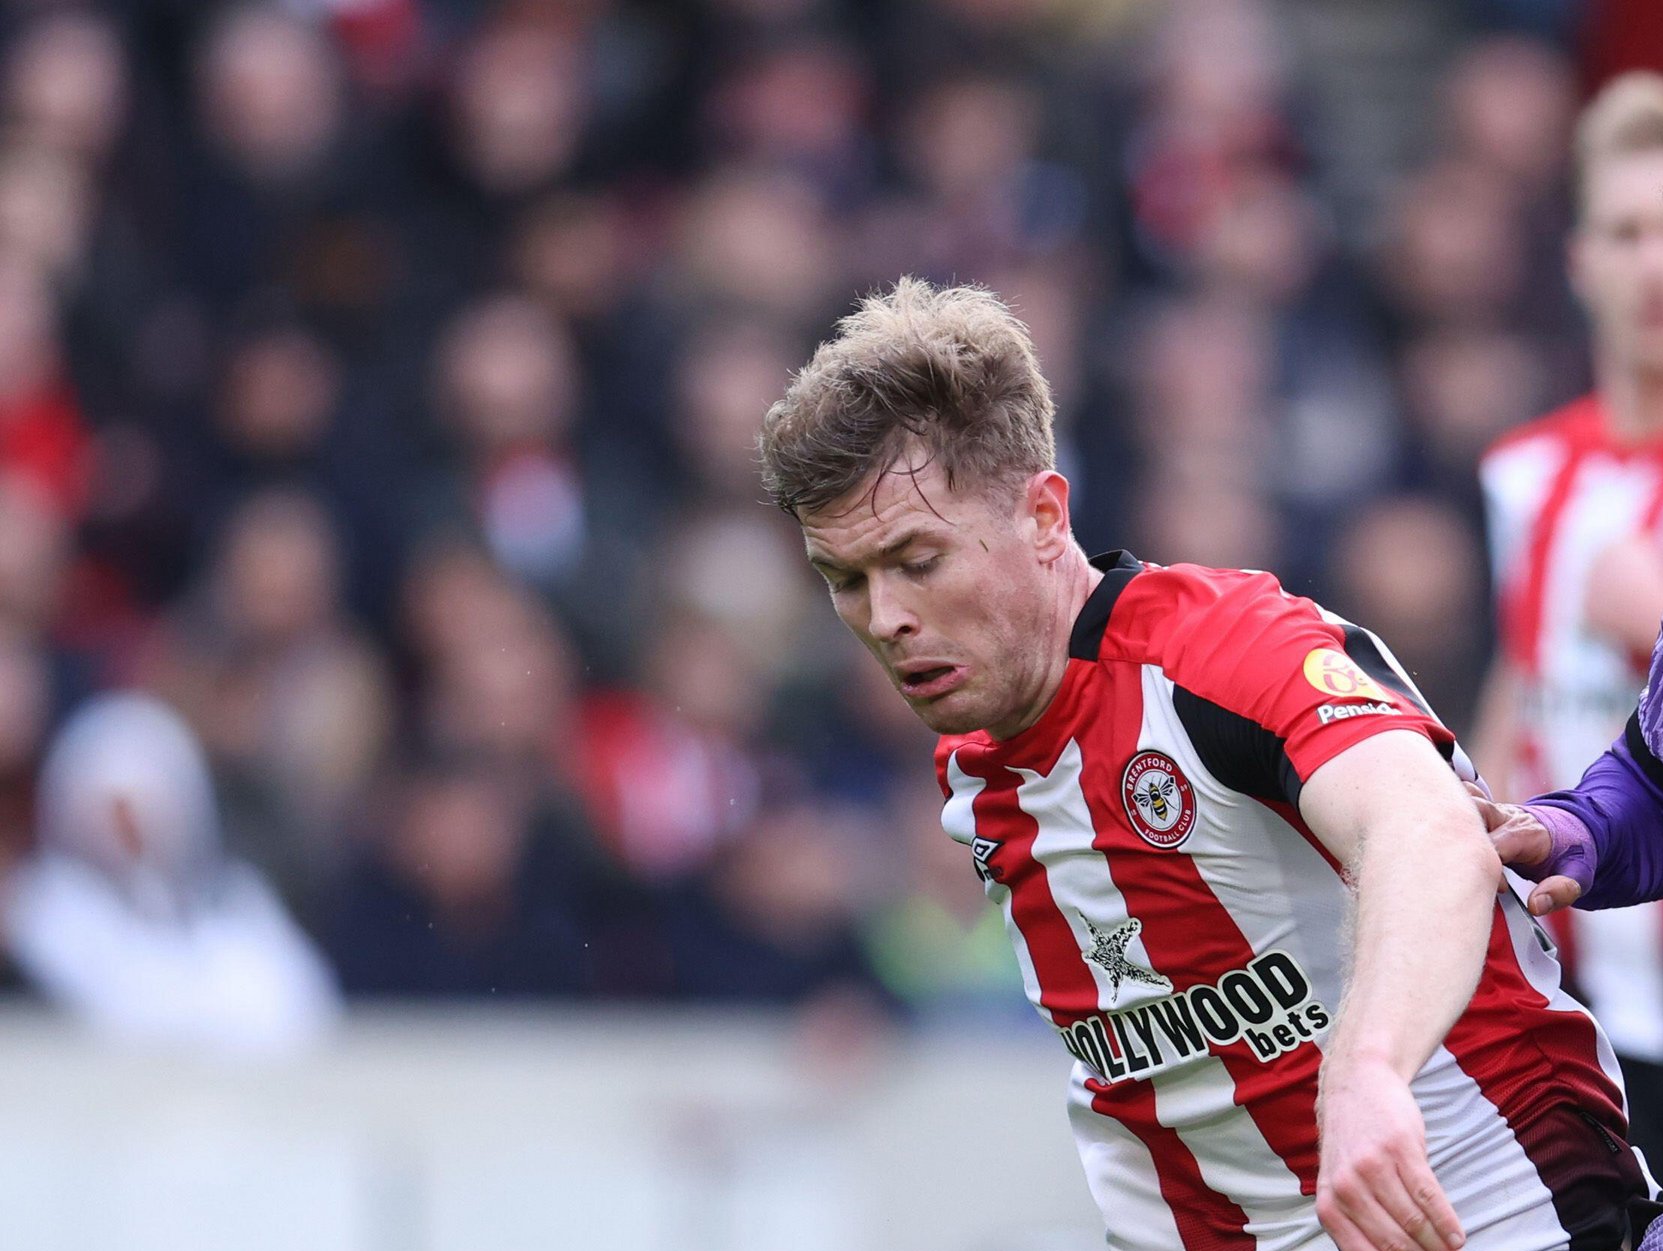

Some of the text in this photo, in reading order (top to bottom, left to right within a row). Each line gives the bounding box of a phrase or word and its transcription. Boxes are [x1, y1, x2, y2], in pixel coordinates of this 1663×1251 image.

[1126, 757, 1173, 791] BRENTFORD
[1144, 809, 1192, 843] FOOTBALL CLUB
[1060, 952, 1308, 1080] HOLLYWOOD
[1244, 1003, 1330, 1059] bets
